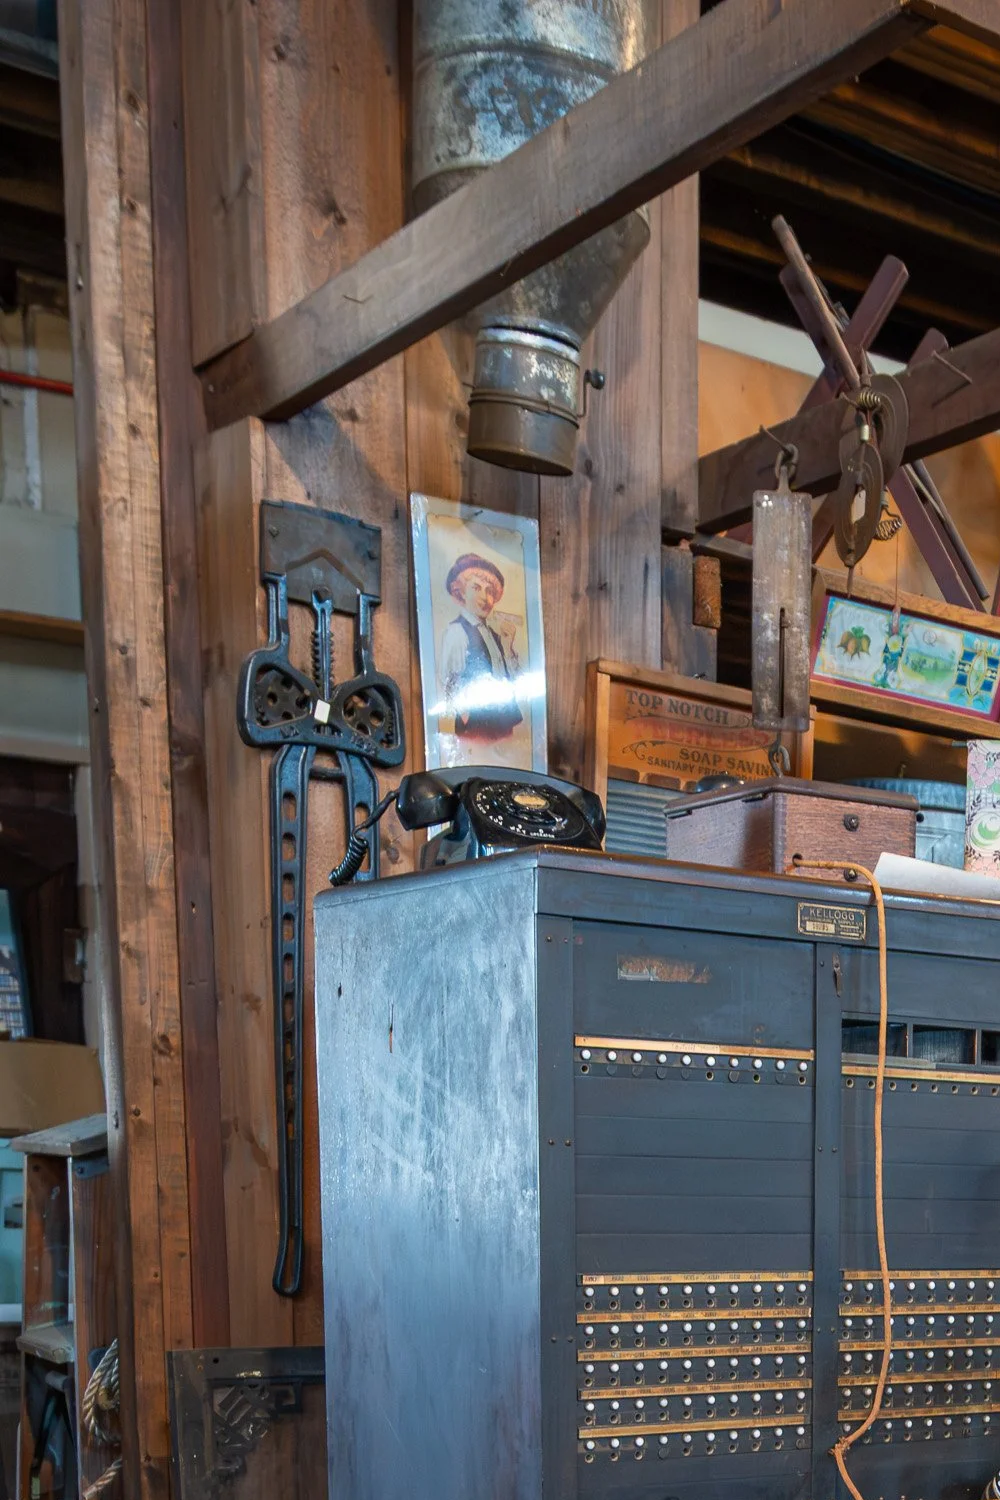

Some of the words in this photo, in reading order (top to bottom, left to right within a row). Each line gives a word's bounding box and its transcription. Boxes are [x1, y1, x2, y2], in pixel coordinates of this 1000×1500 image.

[625, 688, 663, 710] TOP
[667, 697, 729, 726] NOTCH
[646, 755, 696, 774] SANITARY
[679, 748, 722, 766] SOAP
[727, 755, 773, 776] SAVIN
[809, 907, 855, 921] KELLOGG
